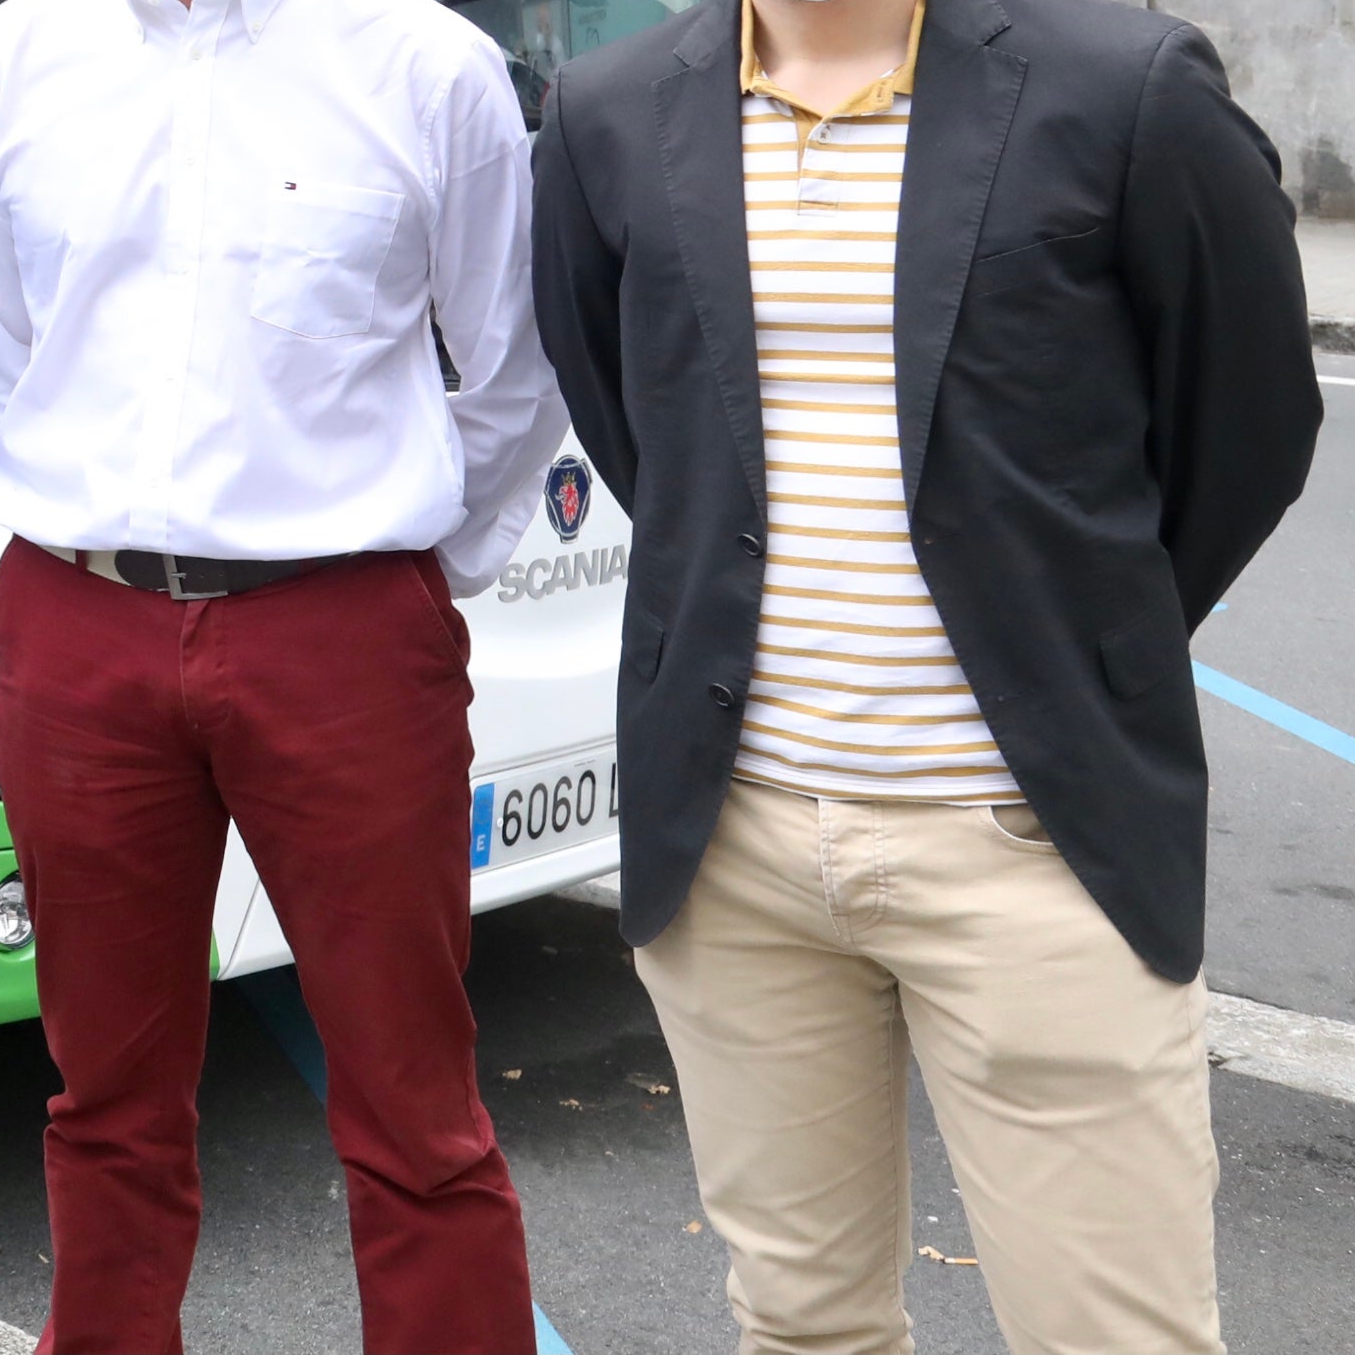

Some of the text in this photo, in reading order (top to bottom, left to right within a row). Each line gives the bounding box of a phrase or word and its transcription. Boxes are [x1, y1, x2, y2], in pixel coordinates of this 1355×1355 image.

[497, 544, 630, 604] SCANIA
[501, 769, 597, 847] 6060
[476, 835, 487, 852] E
